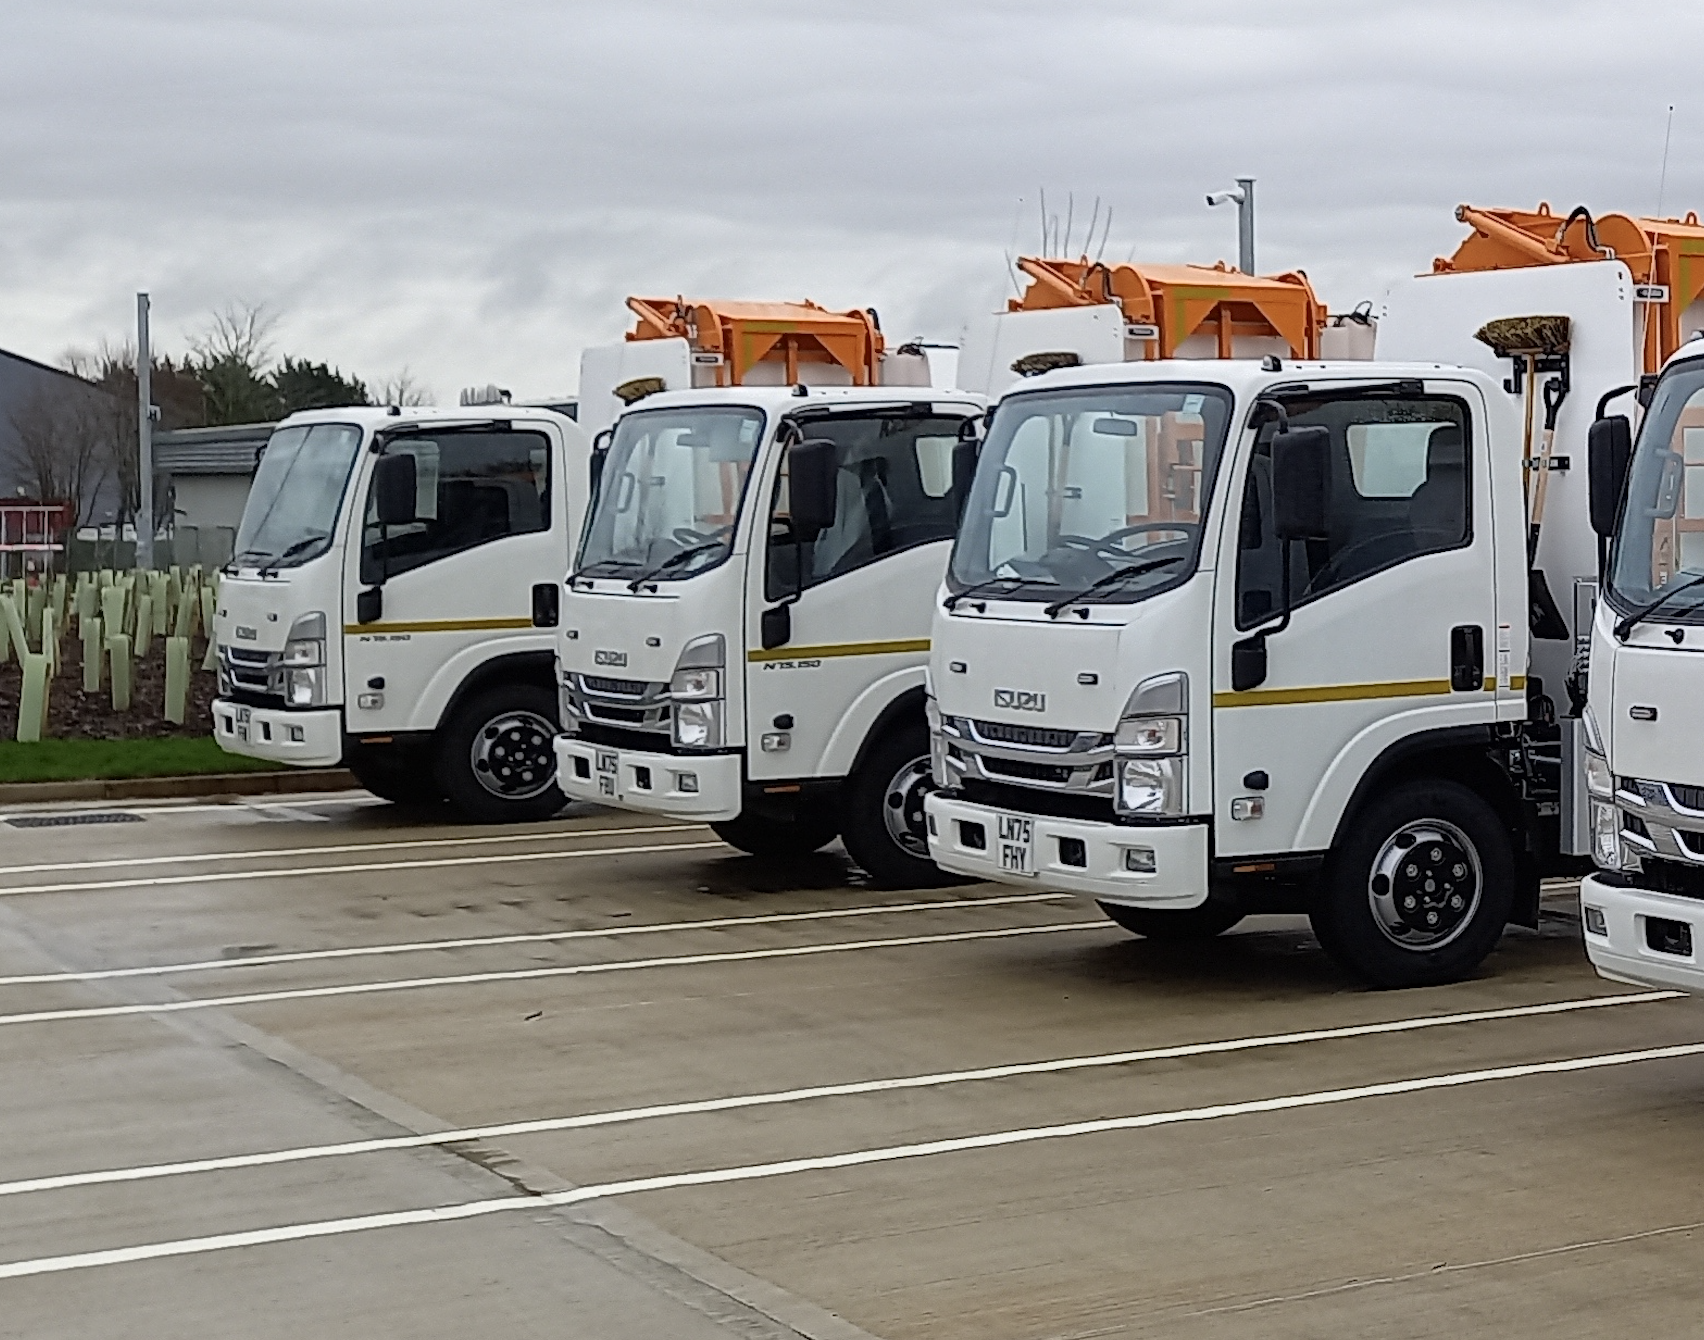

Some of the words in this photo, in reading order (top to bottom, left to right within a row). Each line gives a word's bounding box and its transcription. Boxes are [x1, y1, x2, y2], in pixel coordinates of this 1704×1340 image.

[994, 689, 1046, 712] ISUZU
[998, 815, 1031, 843] LN75
[1003, 844, 1027, 870] FHY
